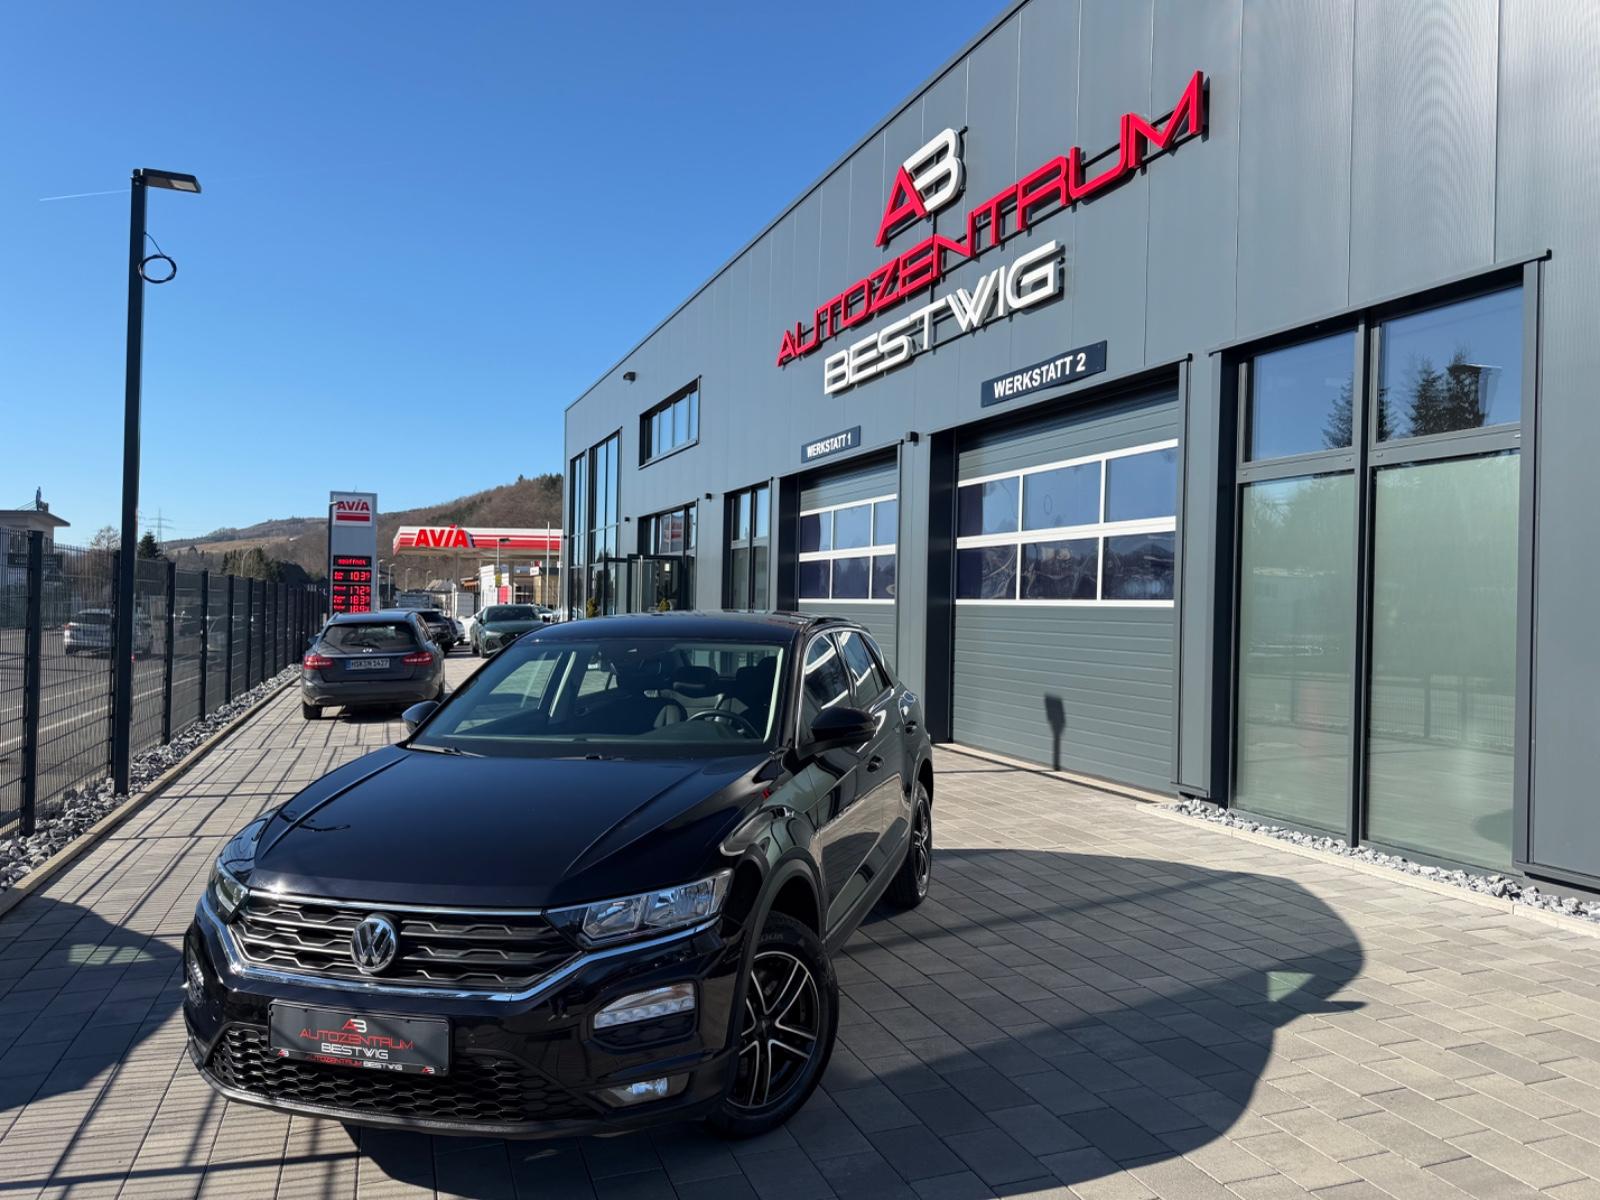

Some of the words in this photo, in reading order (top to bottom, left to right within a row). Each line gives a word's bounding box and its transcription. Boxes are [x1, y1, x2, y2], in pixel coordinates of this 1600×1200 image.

[775, 70, 1205, 368] AUTOZENTRUM
[824, 239, 1063, 395] BESTWIG
[993, 355, 1073, 398] WERKSTATT
[1075, 352, 1087, 373] 2
[807, 433, 847, 458] WERKSTATT
[847, 431, 852, 446] 1
[299, 1028, 416, 1050] AUTOZENTRUM
[321, 1042, 389, 1060] BESTWIG
